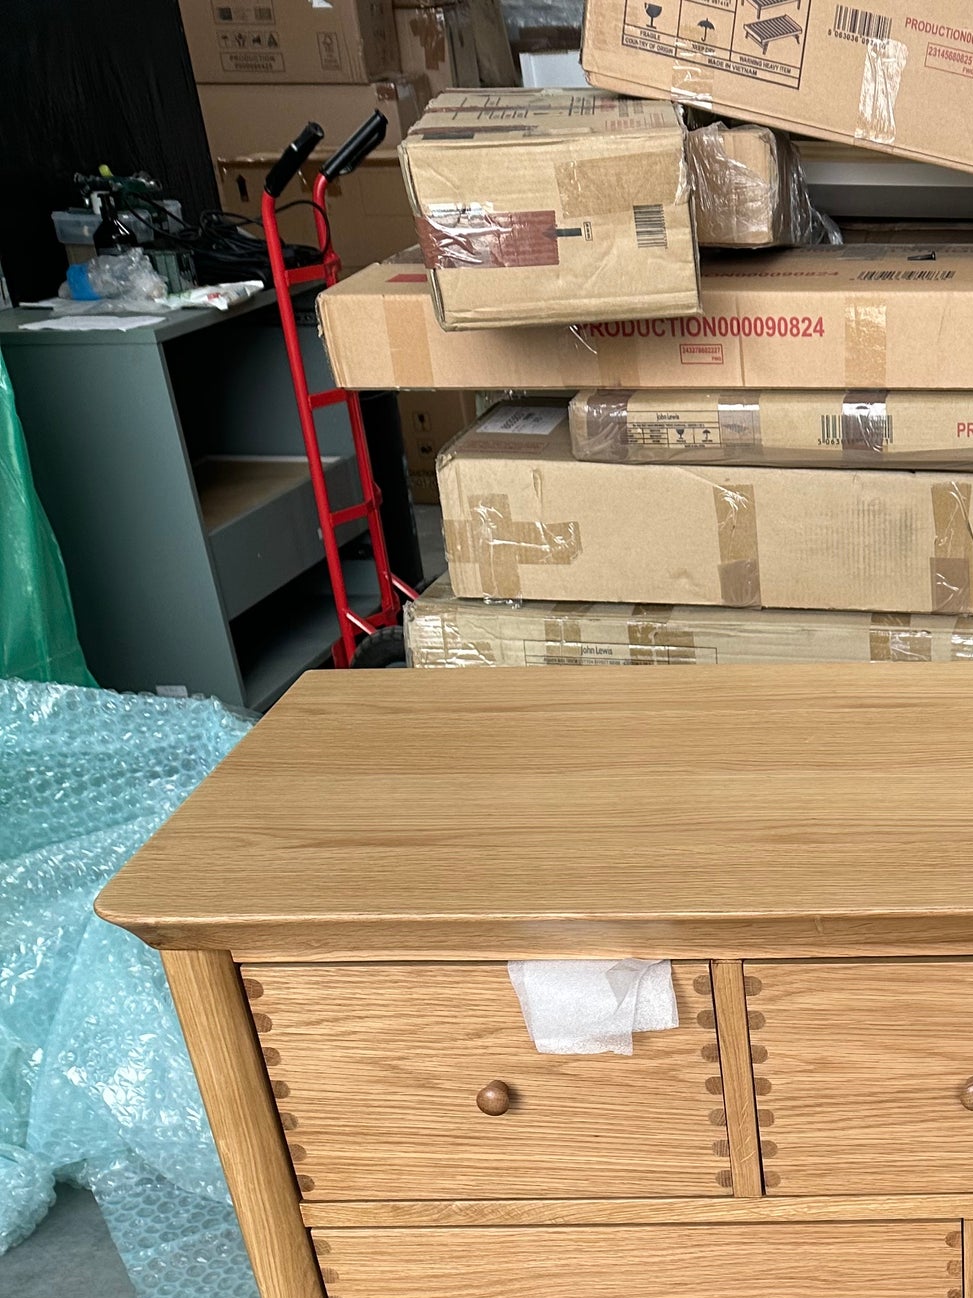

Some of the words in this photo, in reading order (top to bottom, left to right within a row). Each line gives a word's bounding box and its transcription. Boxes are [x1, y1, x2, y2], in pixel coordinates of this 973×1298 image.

[640, 30, 661, 41] FRAGILE
[708, 58, 724, 68] MADE
[725, 62, 731, 70] IN
[732, 63, 757, 76] VIETNAM
[581, 645, 595, 656] John
[595, 647, 613, 656] Lewis
